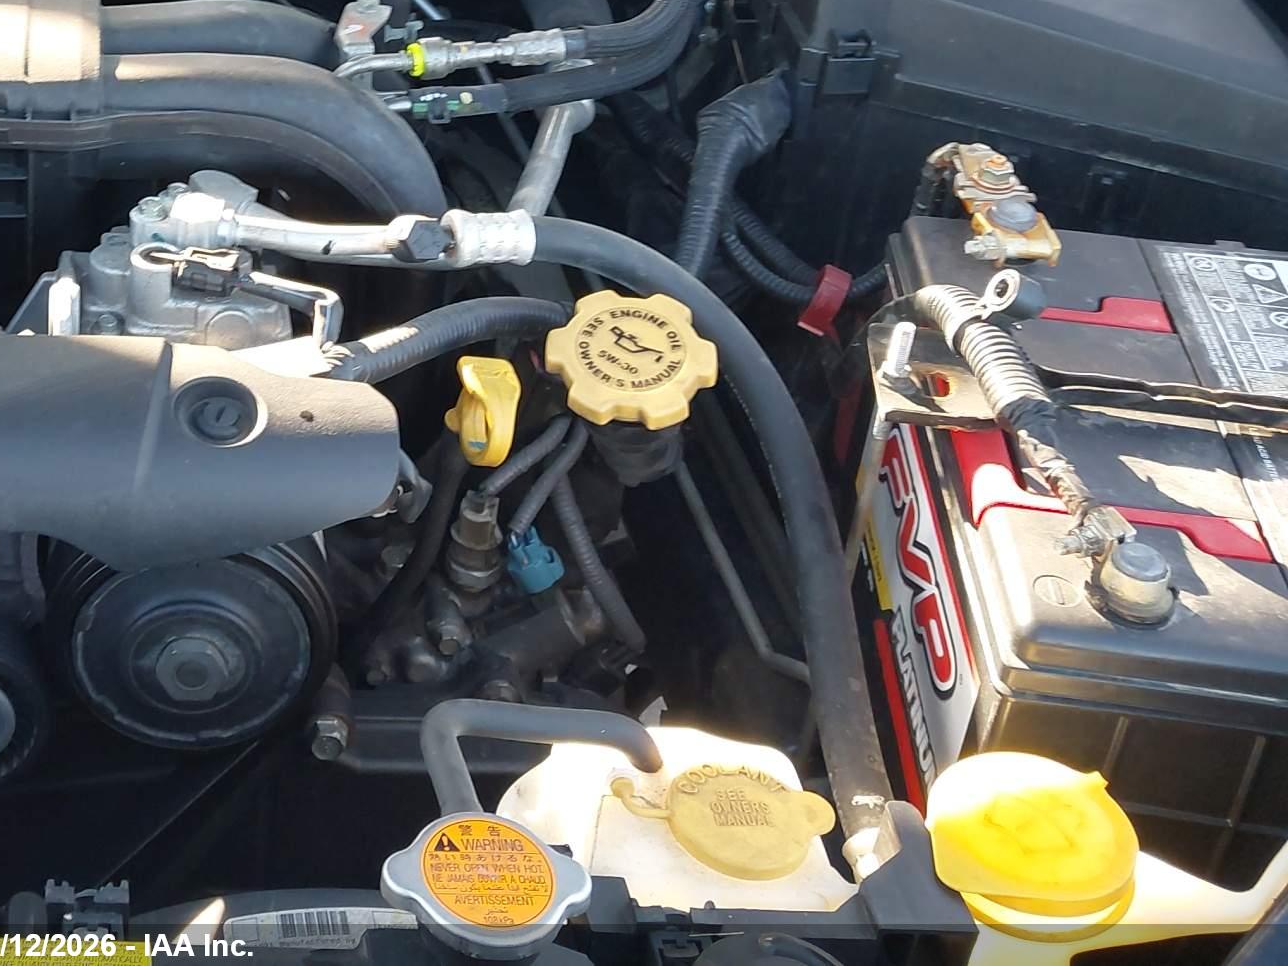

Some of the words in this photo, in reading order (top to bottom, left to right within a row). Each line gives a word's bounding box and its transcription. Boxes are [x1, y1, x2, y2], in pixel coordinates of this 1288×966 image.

[582, 316, 605, 338] SEE
[609, 309, 669, 329] ENGINE
[666, 330, 683, 351] OIL
[578, 341, 626, 388] OWNER'S
[596, 349, 640, 375] 5W-30
[630, 358, 682, 389] MANUAL
[677, 764, 789, 795] COOLANT
[715, 788, 747, 801] SEE
[710, 801, 770, 815] OWNERS
[713, 813, 776, 827] MANUAL
[461, 838, 524, 852] WARNING
[430, 862, 461, 872] NEVER
[463, 862, 489, 872] OPEN
[494, 863, 521, 873] WHEN
[454, 895, 535, 906] AVERTISSEMENT
